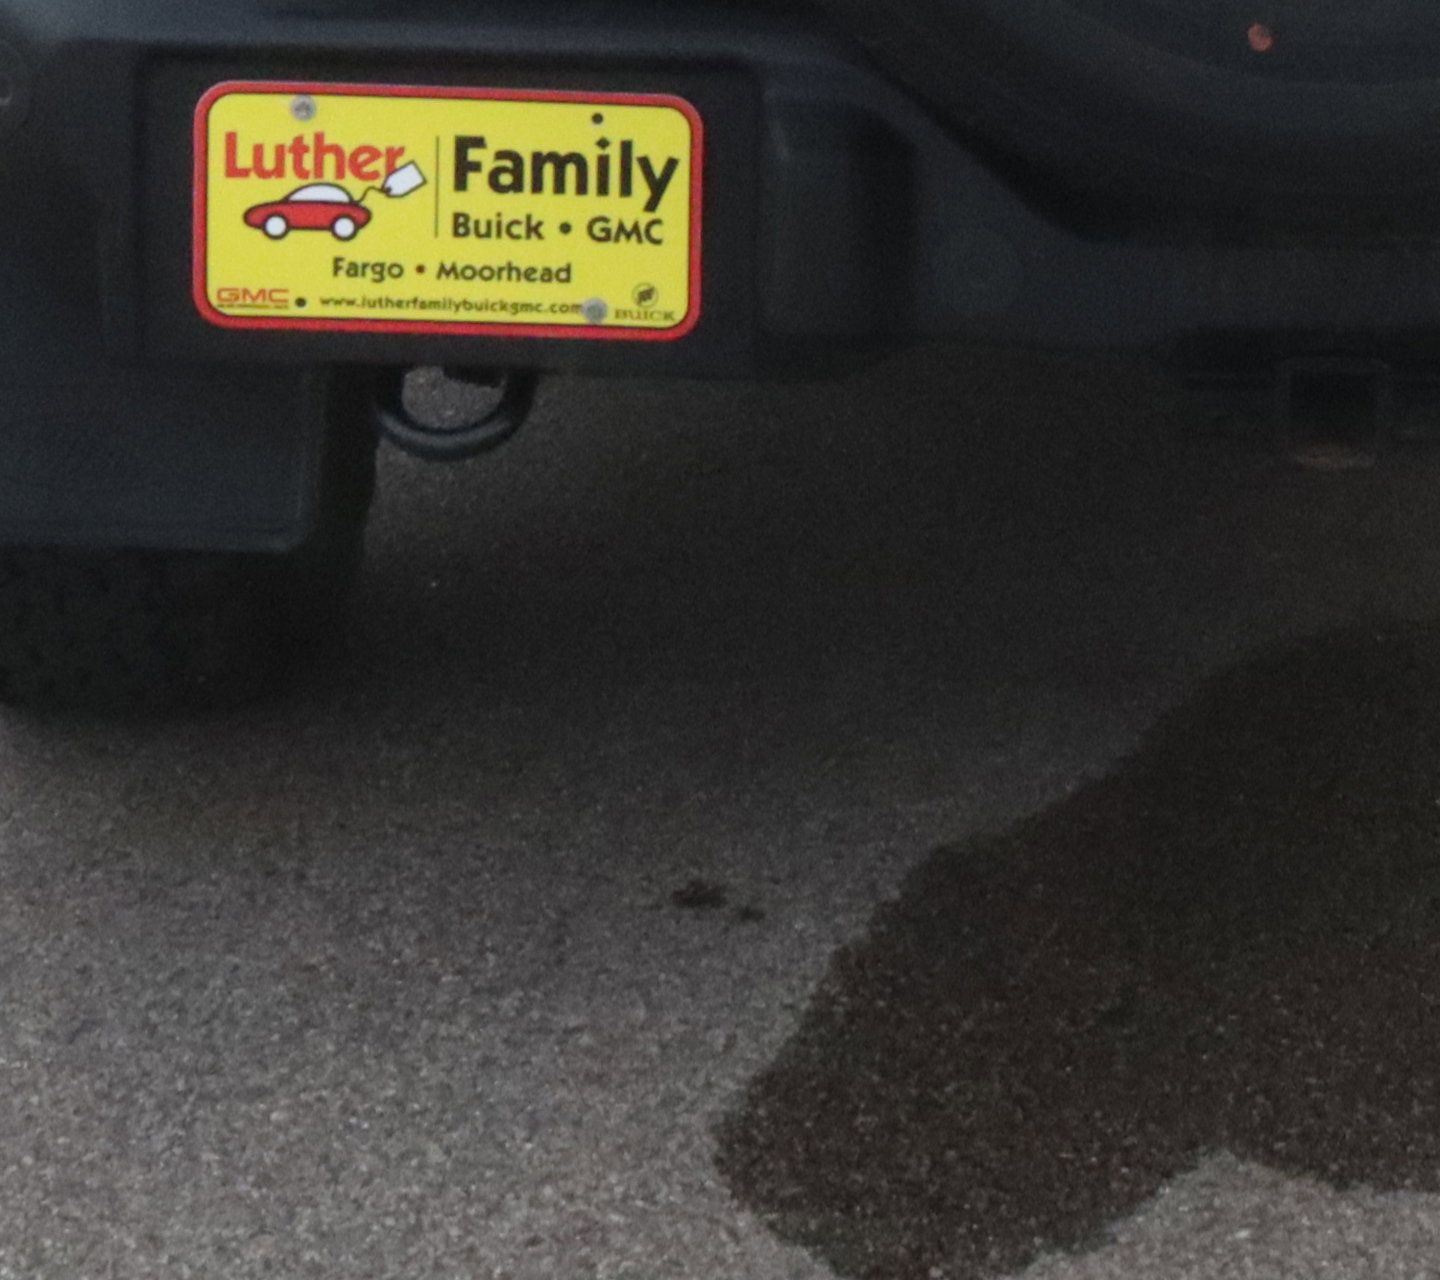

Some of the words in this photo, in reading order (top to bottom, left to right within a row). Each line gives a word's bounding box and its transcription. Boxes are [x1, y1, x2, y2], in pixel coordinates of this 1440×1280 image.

[224, 131, 406, 182] Luther
[453, 135, 680, 213] Family
[452, 212, 545, 240] Buick
[586, 215, 664, 245] GMC
[332, 256, 405, 283] Fargo
[436, 260, 572, 284] Moorhead
[216, 287, 289, 304] GMC
[319, 294, 584, 316] www.lutherfamilybuickgmc.com
[614, 307, 677, 322] BUICK
